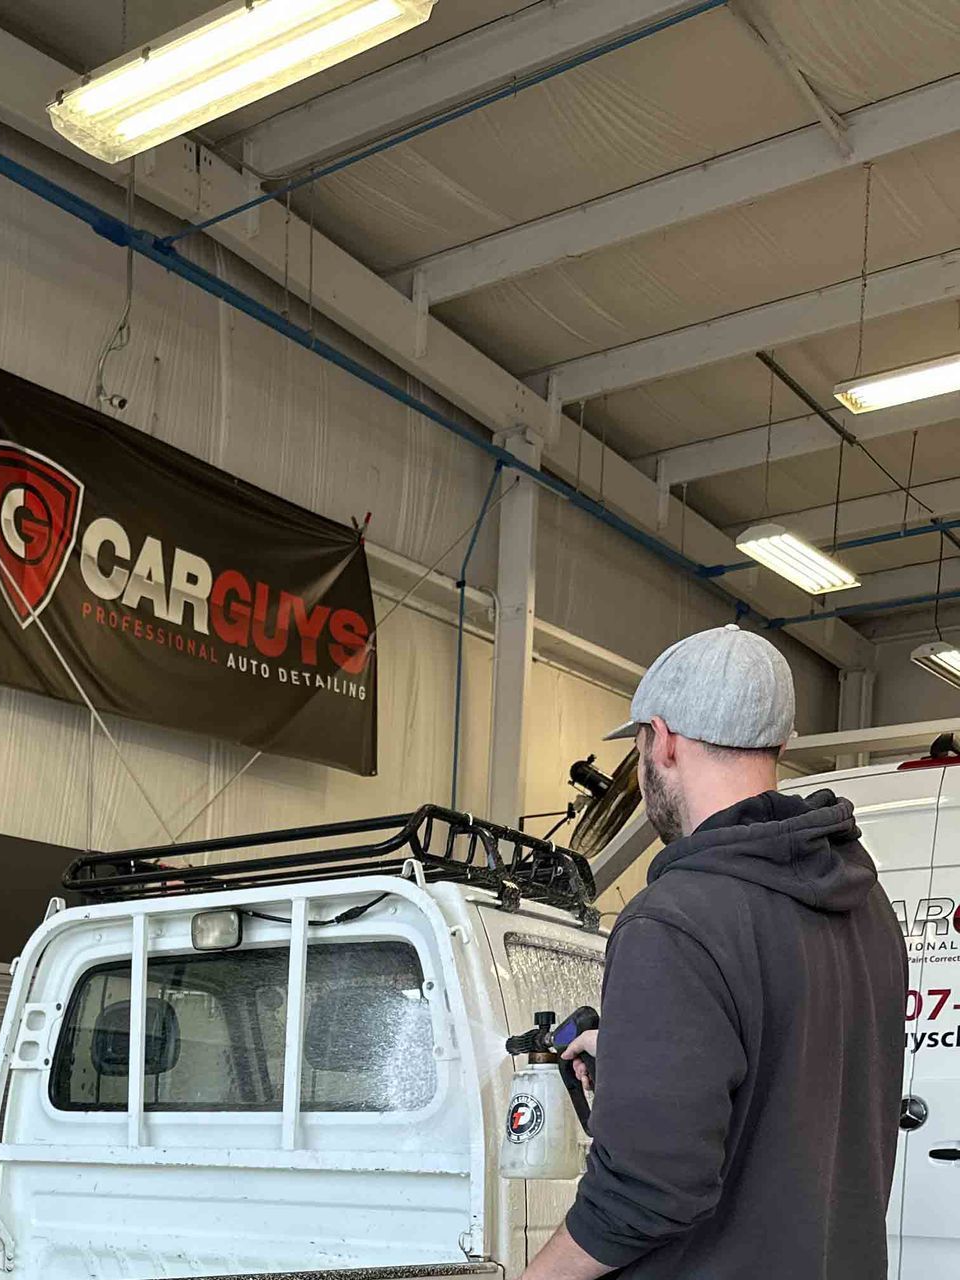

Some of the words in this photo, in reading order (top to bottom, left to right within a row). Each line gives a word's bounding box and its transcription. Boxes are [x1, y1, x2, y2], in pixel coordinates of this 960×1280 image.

[80, 518, 370, 675] CARGUYS
[83, 602, 218, 663] PROFESSIONAL
[227, 652, 270, 679] AUTO
[279, 668, 367, 701] DETAILING
